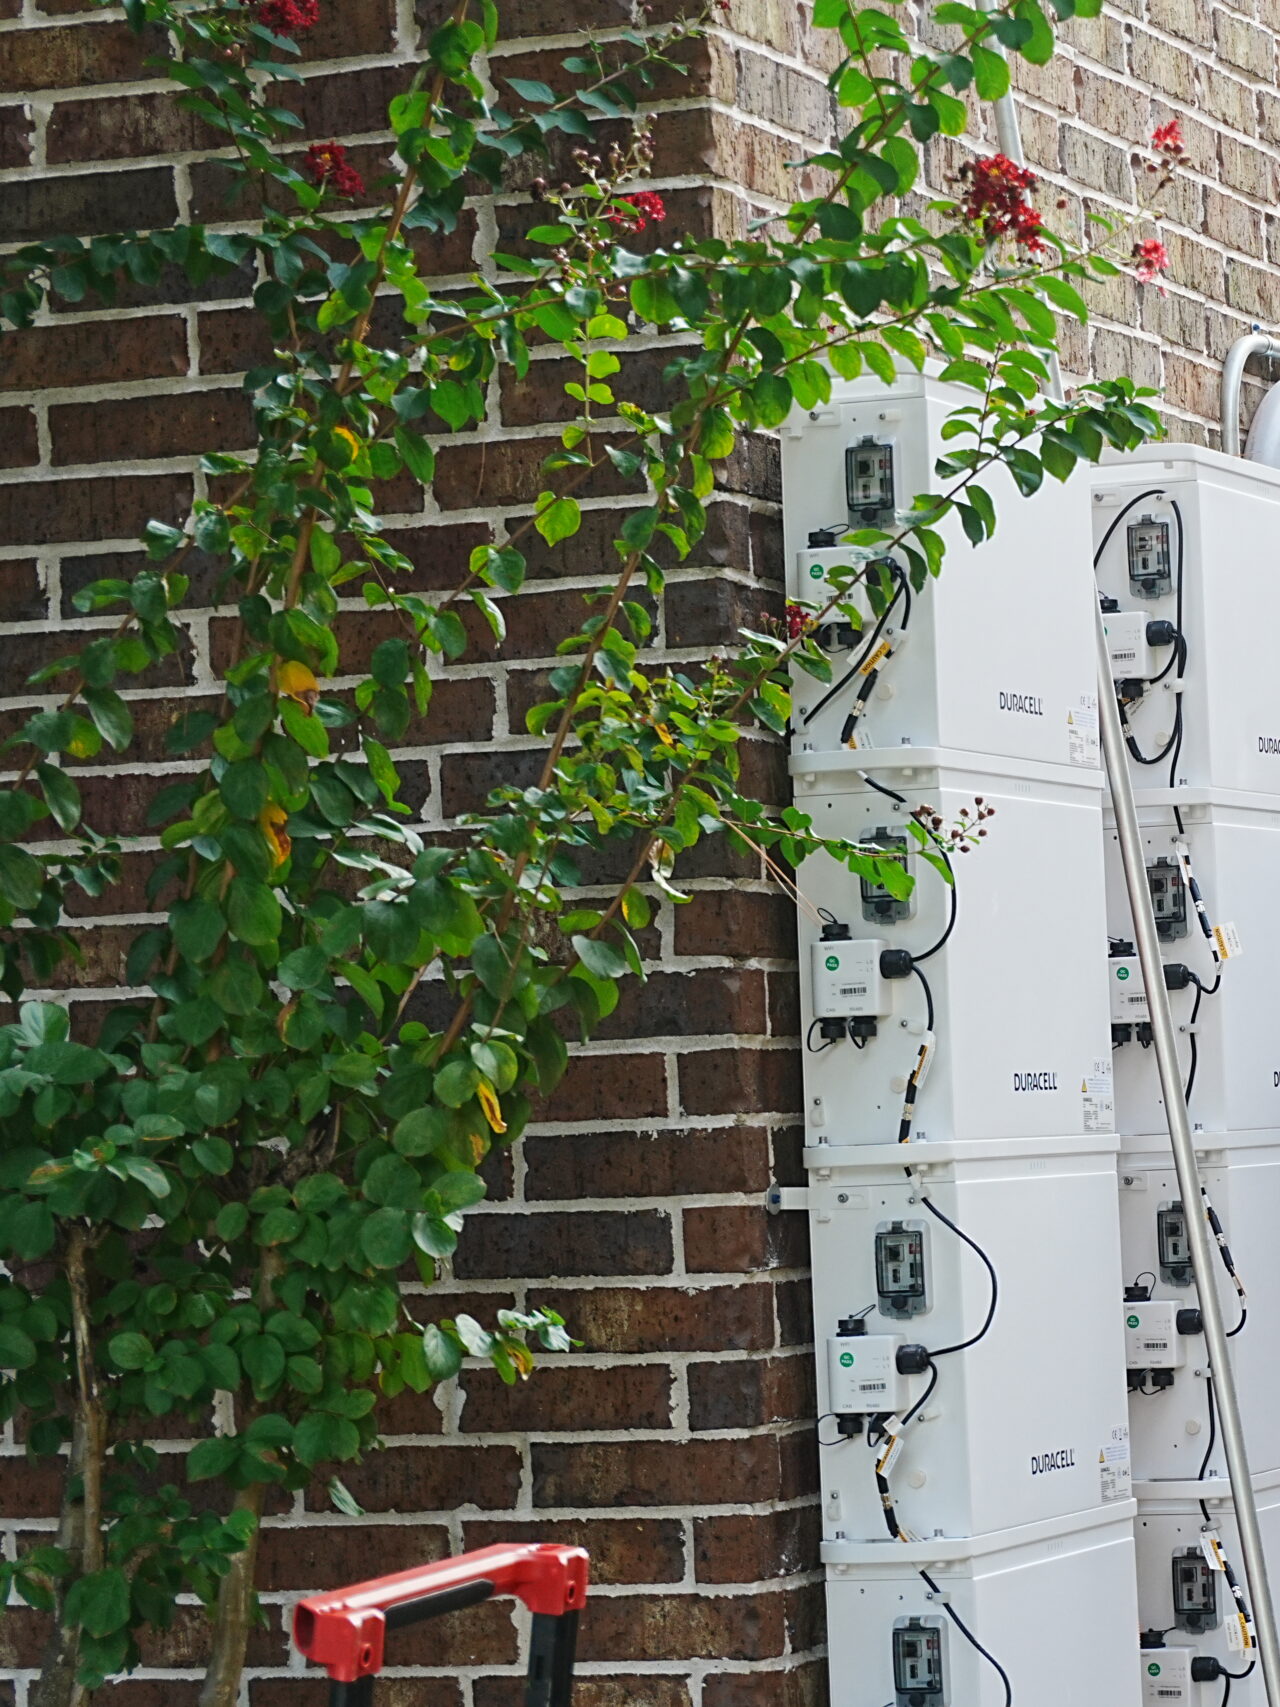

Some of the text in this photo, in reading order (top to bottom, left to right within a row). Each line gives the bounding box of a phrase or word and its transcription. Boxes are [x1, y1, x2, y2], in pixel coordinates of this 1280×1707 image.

[862, 649, 882, 674] CAUTION
[1000, 692, 1043, 716] DURACELL
[1014, 1072, 1057, 1091] DURACELL
[1032, 1449, 1075, 1475] DURACELL
[1240, 1621, 1249, 1646] CAUTION
